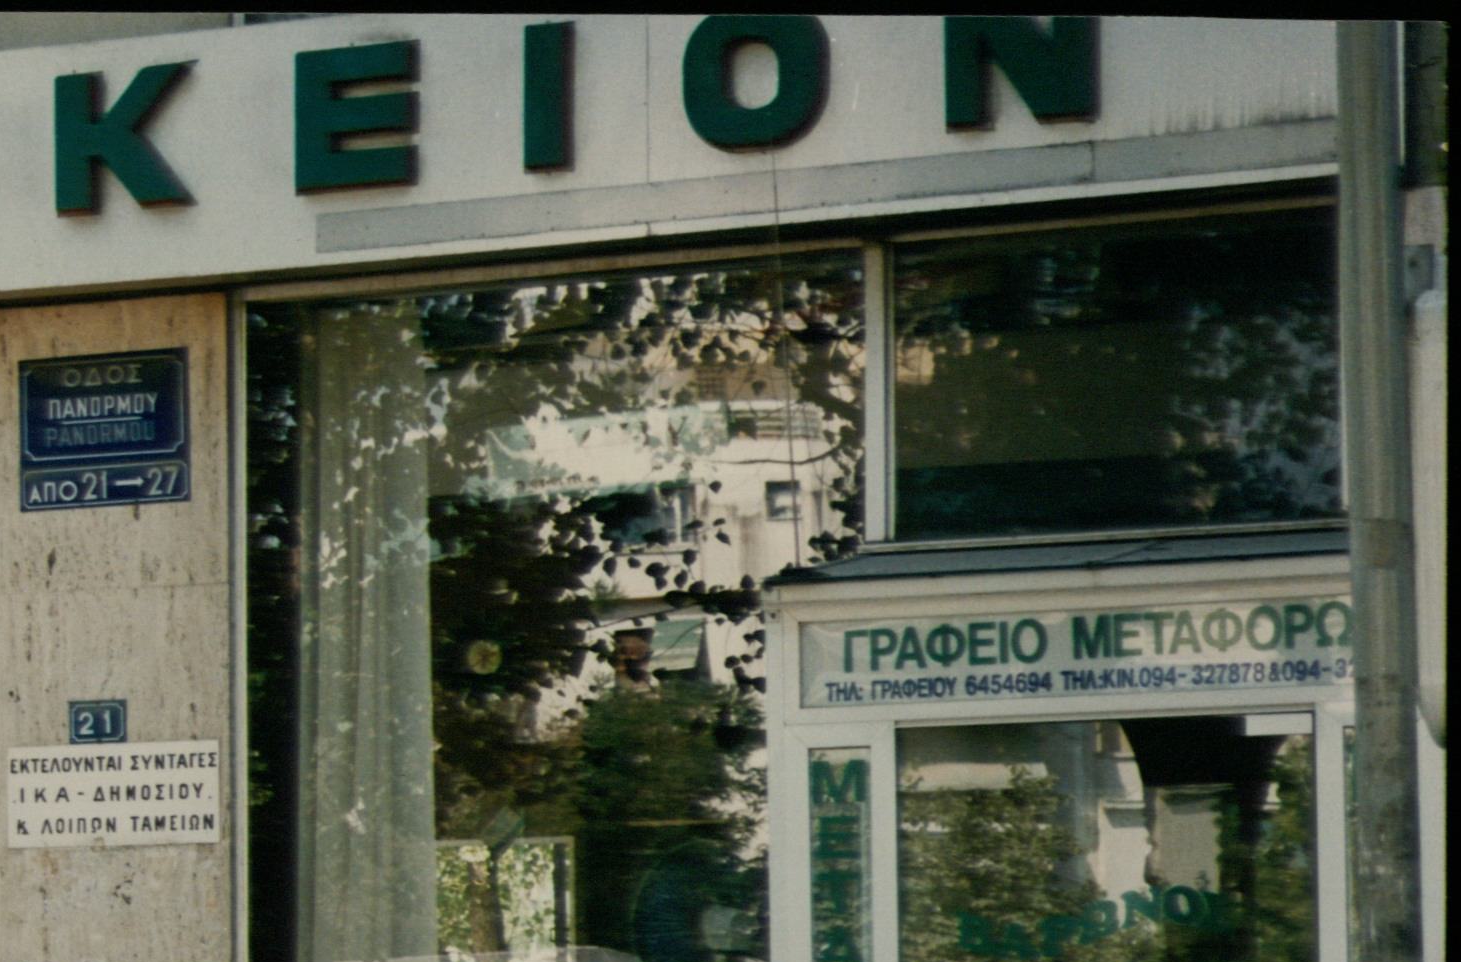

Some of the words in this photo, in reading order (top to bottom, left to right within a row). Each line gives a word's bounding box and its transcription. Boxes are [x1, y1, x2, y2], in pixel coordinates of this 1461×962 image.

[64, 363, 143, 387] ΟΔΟΣ
[48, 391, 158, 420] ΠΑΝΟΡΜΟΥ
[45, 420, 156, 447] PANORMOU
[28, 481, 78, 504] ΑΠΟ
[82, 471, 107, 500] 21
[148, 467, 178, 496] 27
[843, 617, 1049, 674] ΓΡΑΦΕΙΟ
[1071, 600, 1354, 660] ΜΕΤΑΦΟΡΩ
[871, 676, 957, 700] ΓΡΑΦΕΙΟΥ
[965, 671, 1053, 696] 6454694
[78, 710, 112, 736] 21
[10, 755, 122, 775] ΕΚΤΕΛΟΥΝΤΑΙ
[130, 751, 218, 771] ΣΥΝΤΑΓΕΣ
[41, 816, 118, 835] ΛΟΙΠΩΝ
[130, 813, 215, 833] ΤΑΜΕΙΩΝ
